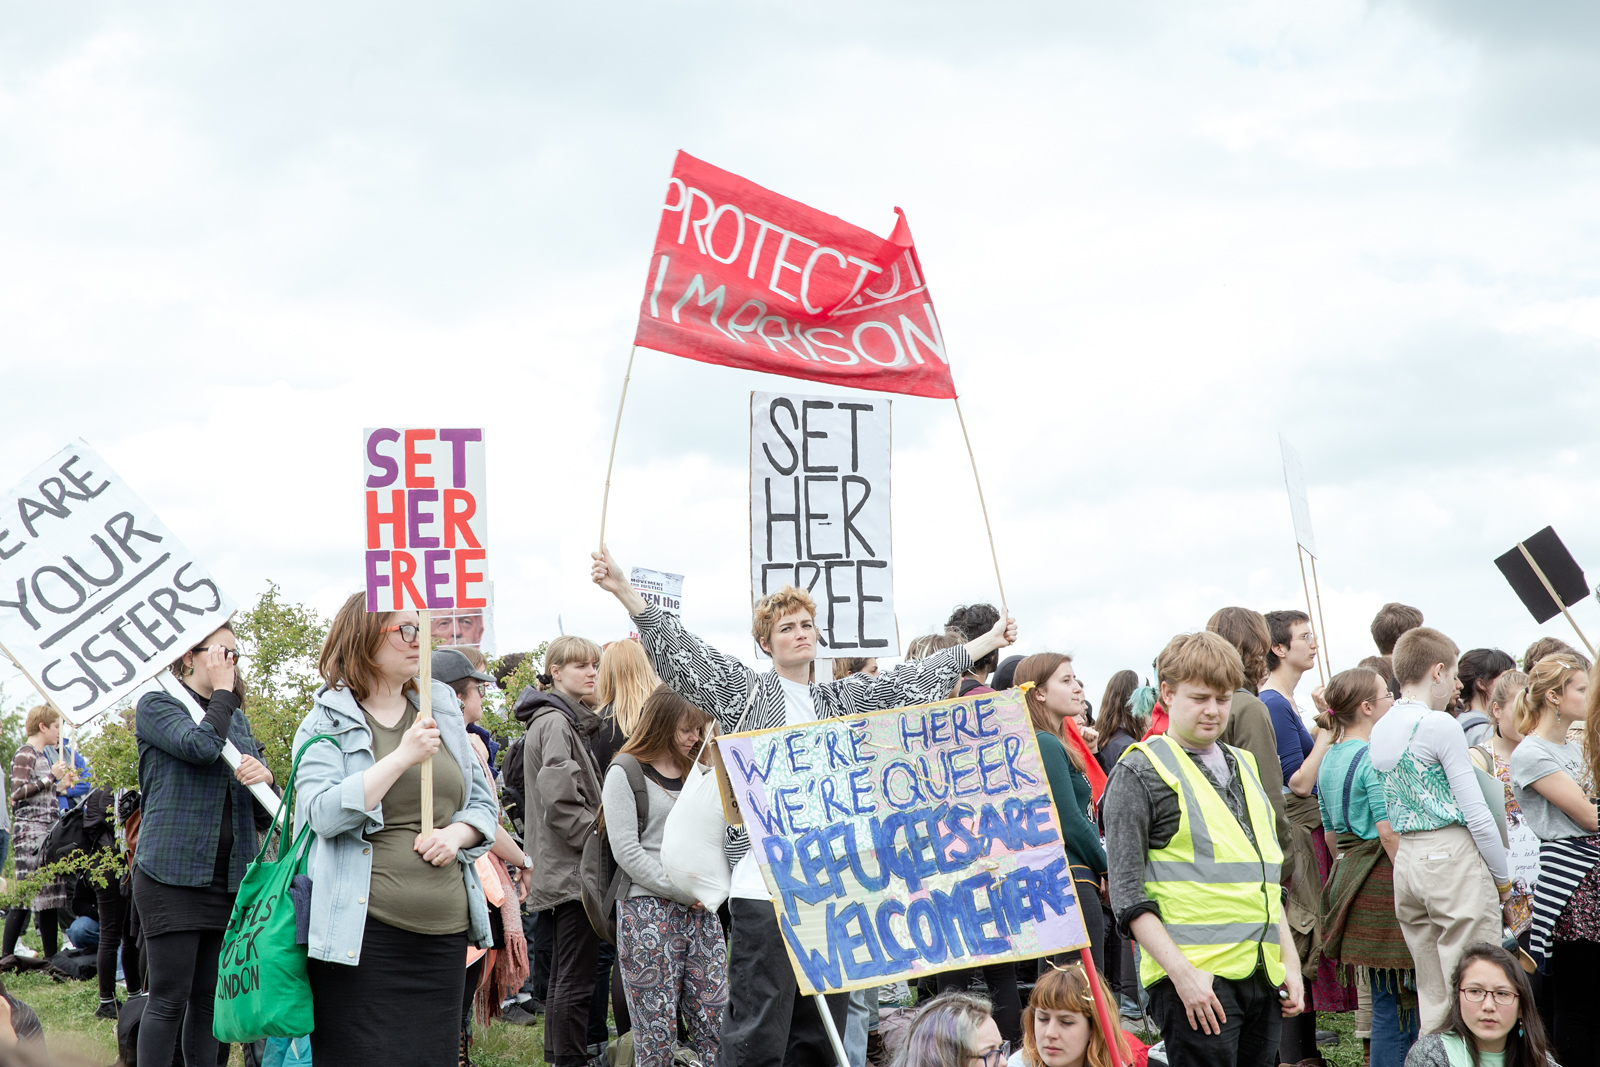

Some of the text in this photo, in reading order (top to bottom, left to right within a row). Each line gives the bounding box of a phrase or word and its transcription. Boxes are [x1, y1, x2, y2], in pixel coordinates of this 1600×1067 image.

[663, 177, 883, 316] PROTECT
[650, 254, 949, 367] IMPRISON
[366, 427, 482, 489] SET
[762, 396, 874, 476] SET
[18, 455, 111, 538] ARE
[366, 488, 483, 550] HER
[765, 474, 875, 562] HER
[0, 511, 163, 631] YOUR
[365, 548, 488, 613] FREE
[630, 578, 664, 587] MOVEMENT
[637, 591, 680, 610] PEN the
[41, 561, 222, 712] SISTERS
[731, 717, 878, 786] WE'RE
[899, 697, 1003, 754] HERE
[747, 734, 1042, 836] WE'RE QUEER
[218, 965, 259, 1000] ONDON
[220, 926, 265, 969] OCK
